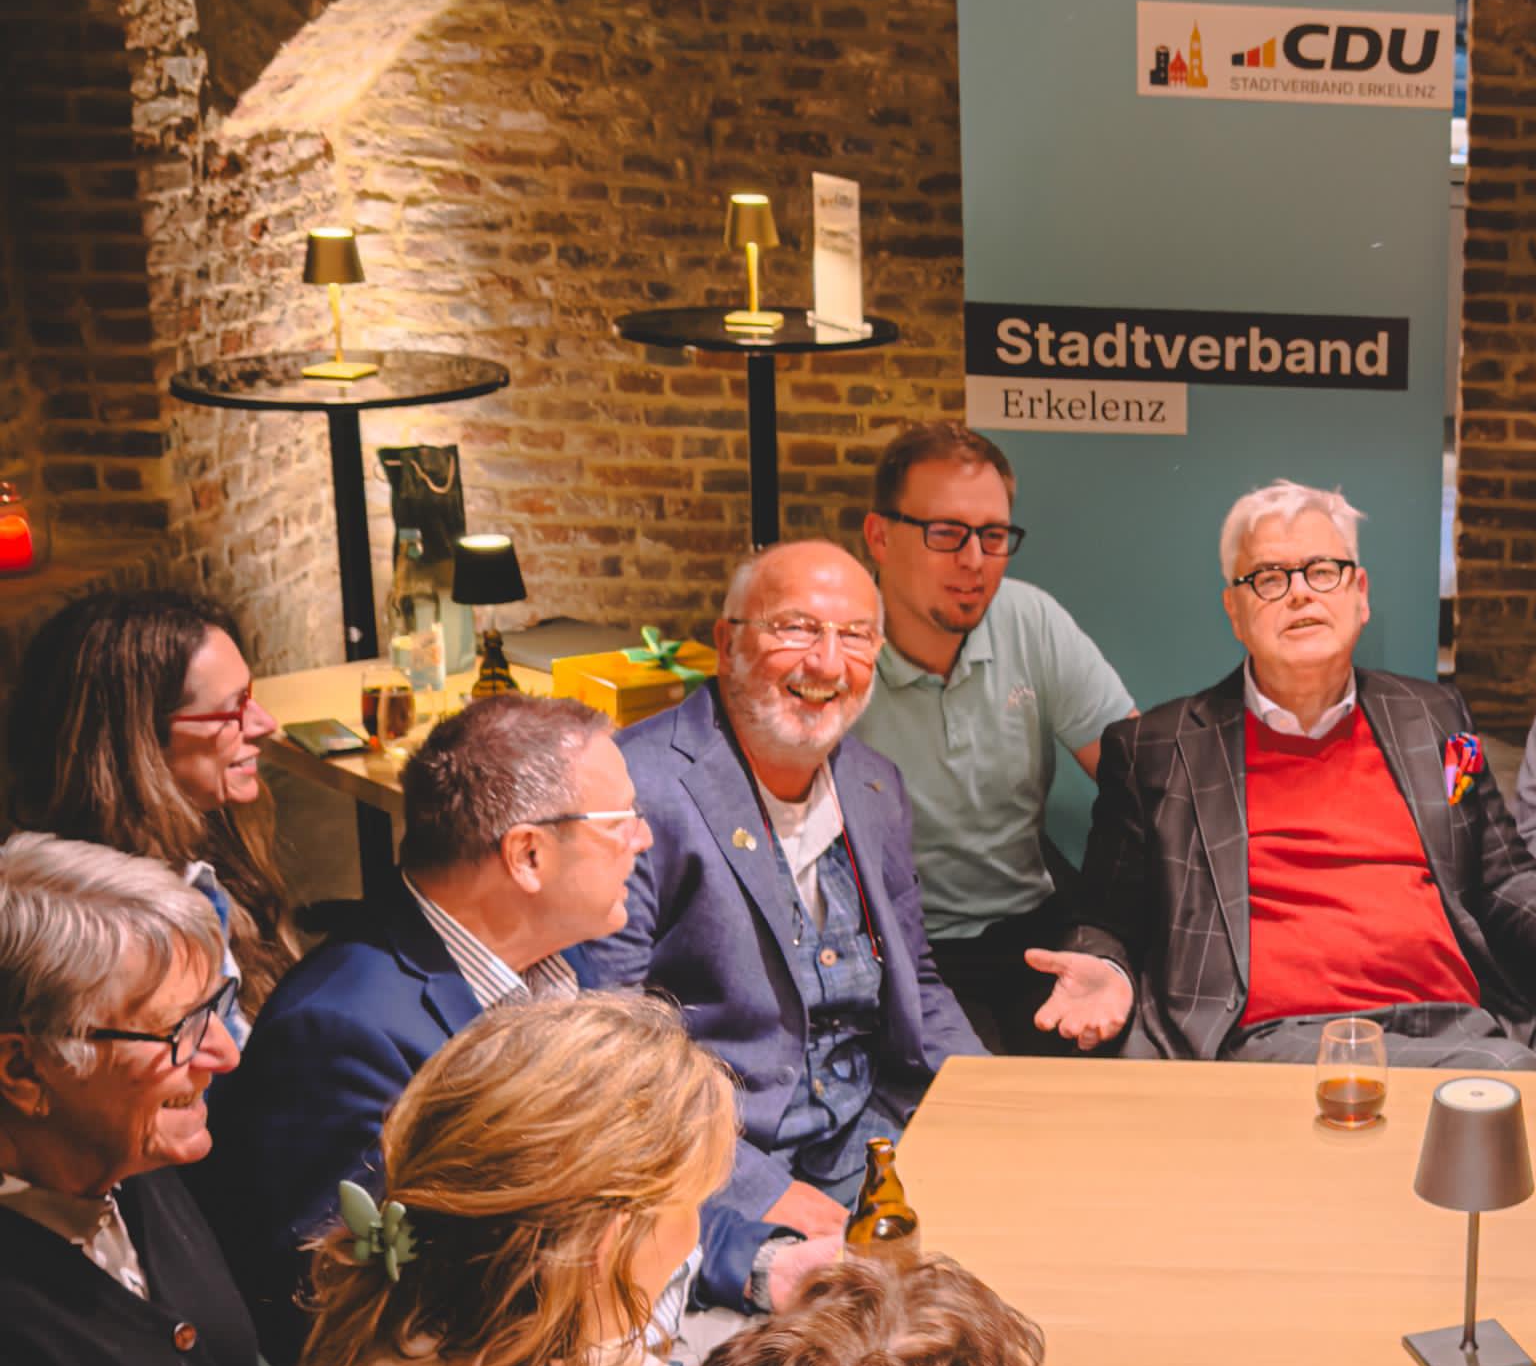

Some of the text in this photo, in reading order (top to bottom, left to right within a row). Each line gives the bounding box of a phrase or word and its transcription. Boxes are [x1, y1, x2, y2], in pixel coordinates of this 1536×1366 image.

[1282, 23, 1440, 75] CDU
[1229, 76, 1437, 100] STADTVERBAND ERKELENZ
[995, 317, 1390, 377] Stadtverband
[1001, 388, 1167, 423] Erkelenz
